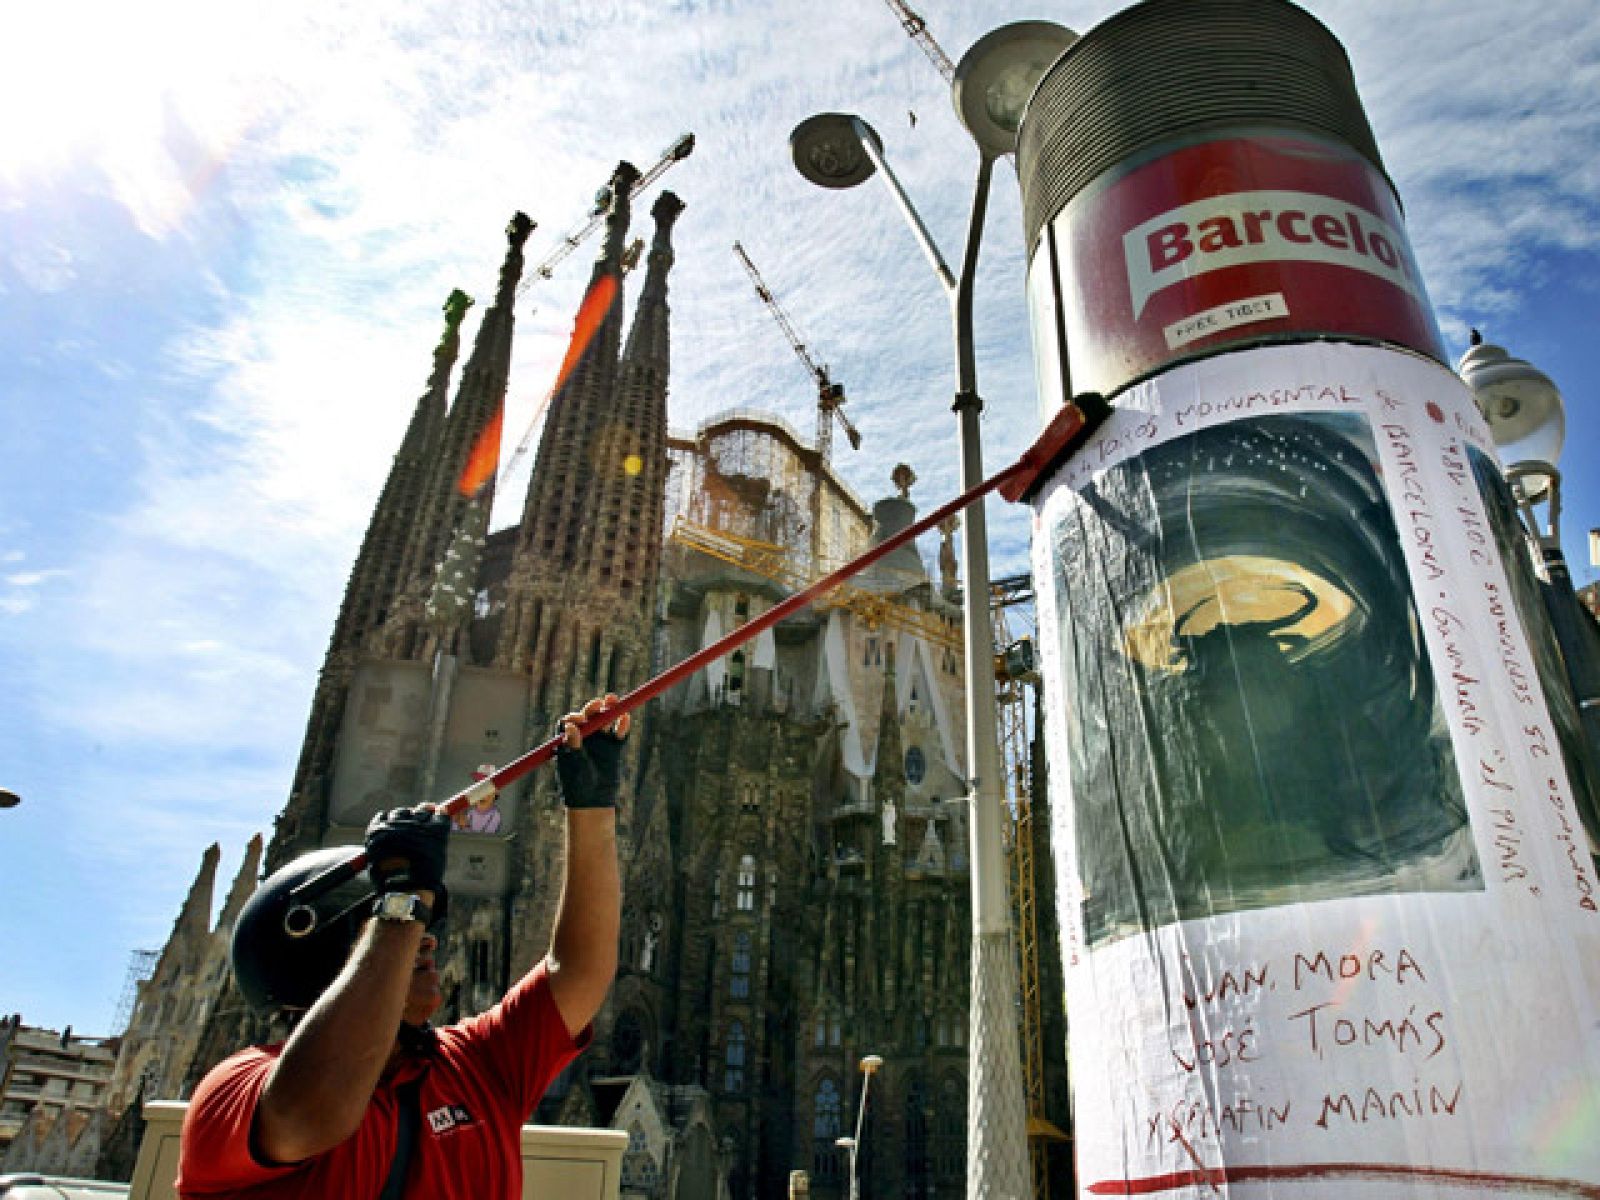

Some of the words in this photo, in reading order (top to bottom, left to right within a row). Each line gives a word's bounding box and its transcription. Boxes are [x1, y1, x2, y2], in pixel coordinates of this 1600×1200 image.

[1147, 209, 1406, 276] Barcelo
[1175, 384, 1361, 427] MONUMENTAL
[1380, 423, 1446, 581] BARCELONA
[1294, 948, 1428, 991] MORA
[1287, 999, 1447, 1062] TOMÁS
